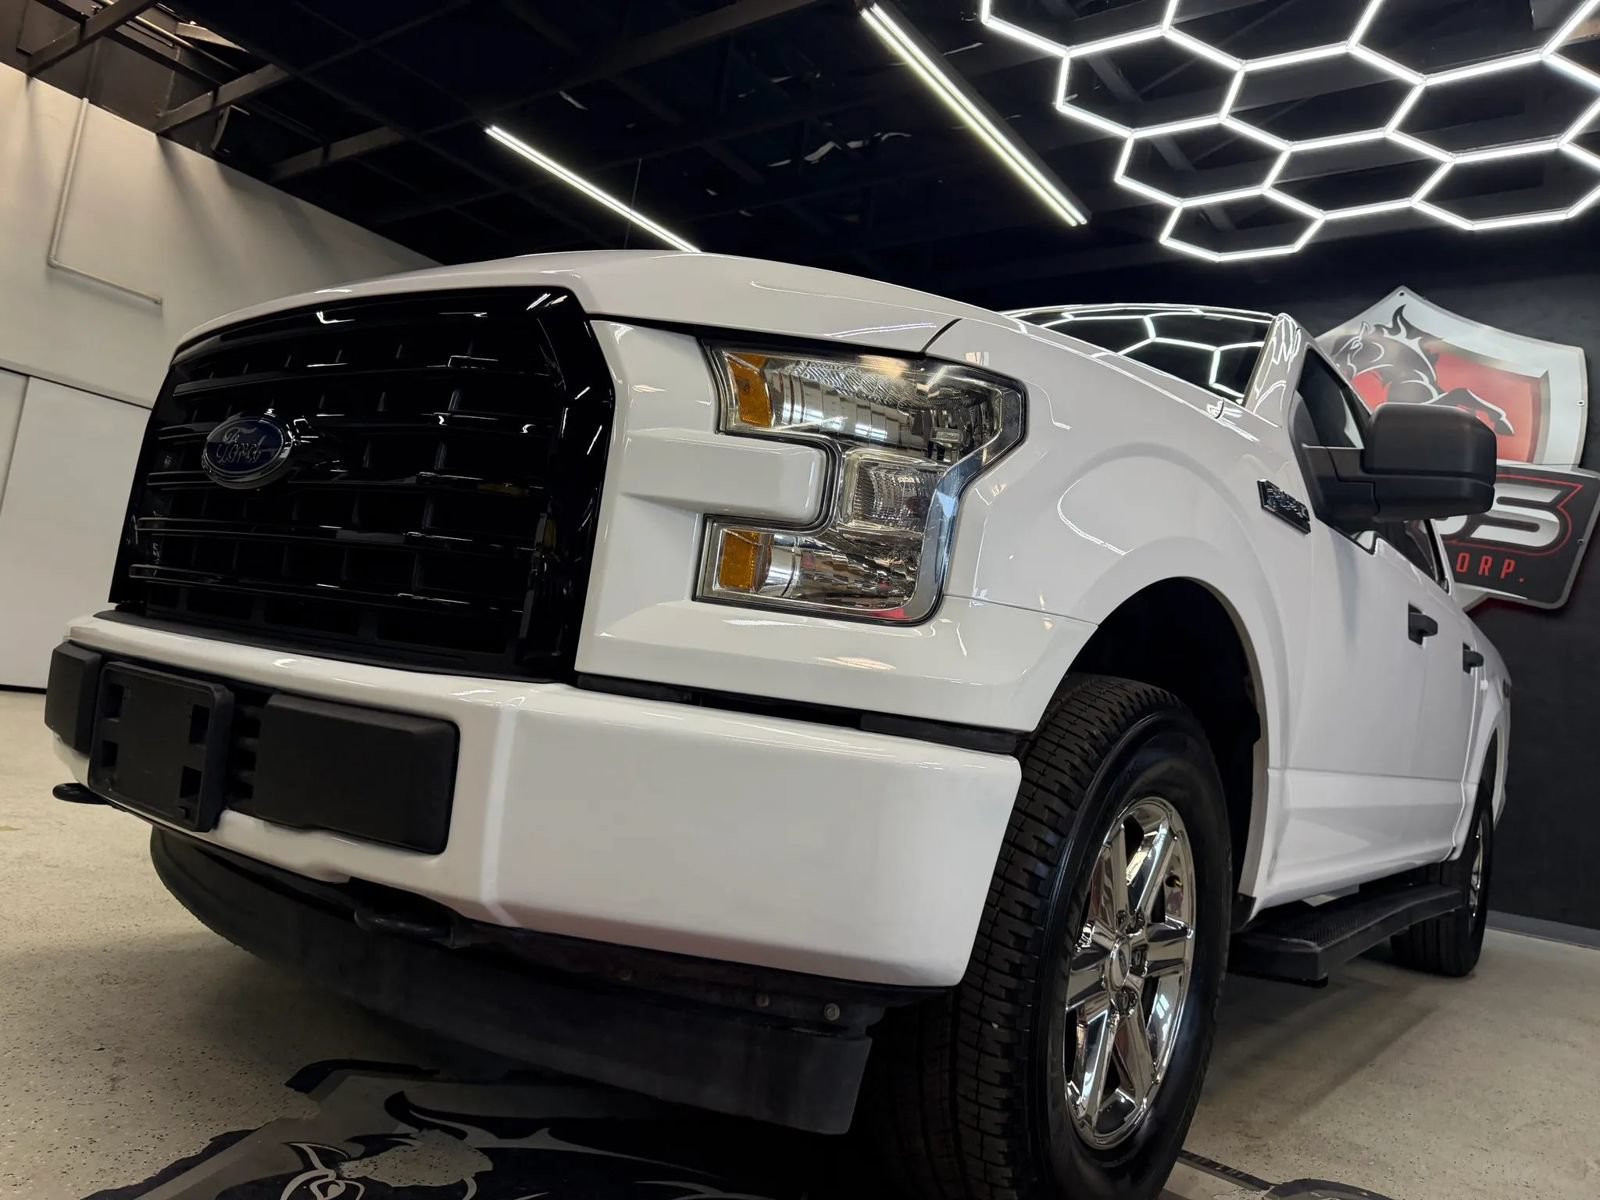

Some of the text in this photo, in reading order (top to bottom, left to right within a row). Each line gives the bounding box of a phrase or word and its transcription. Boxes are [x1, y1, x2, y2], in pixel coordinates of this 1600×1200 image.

[215, 426, 267, 464] Ford
[1430, 483, 1561, 547] S
[1455, 551, 1526, 583] ORP.
